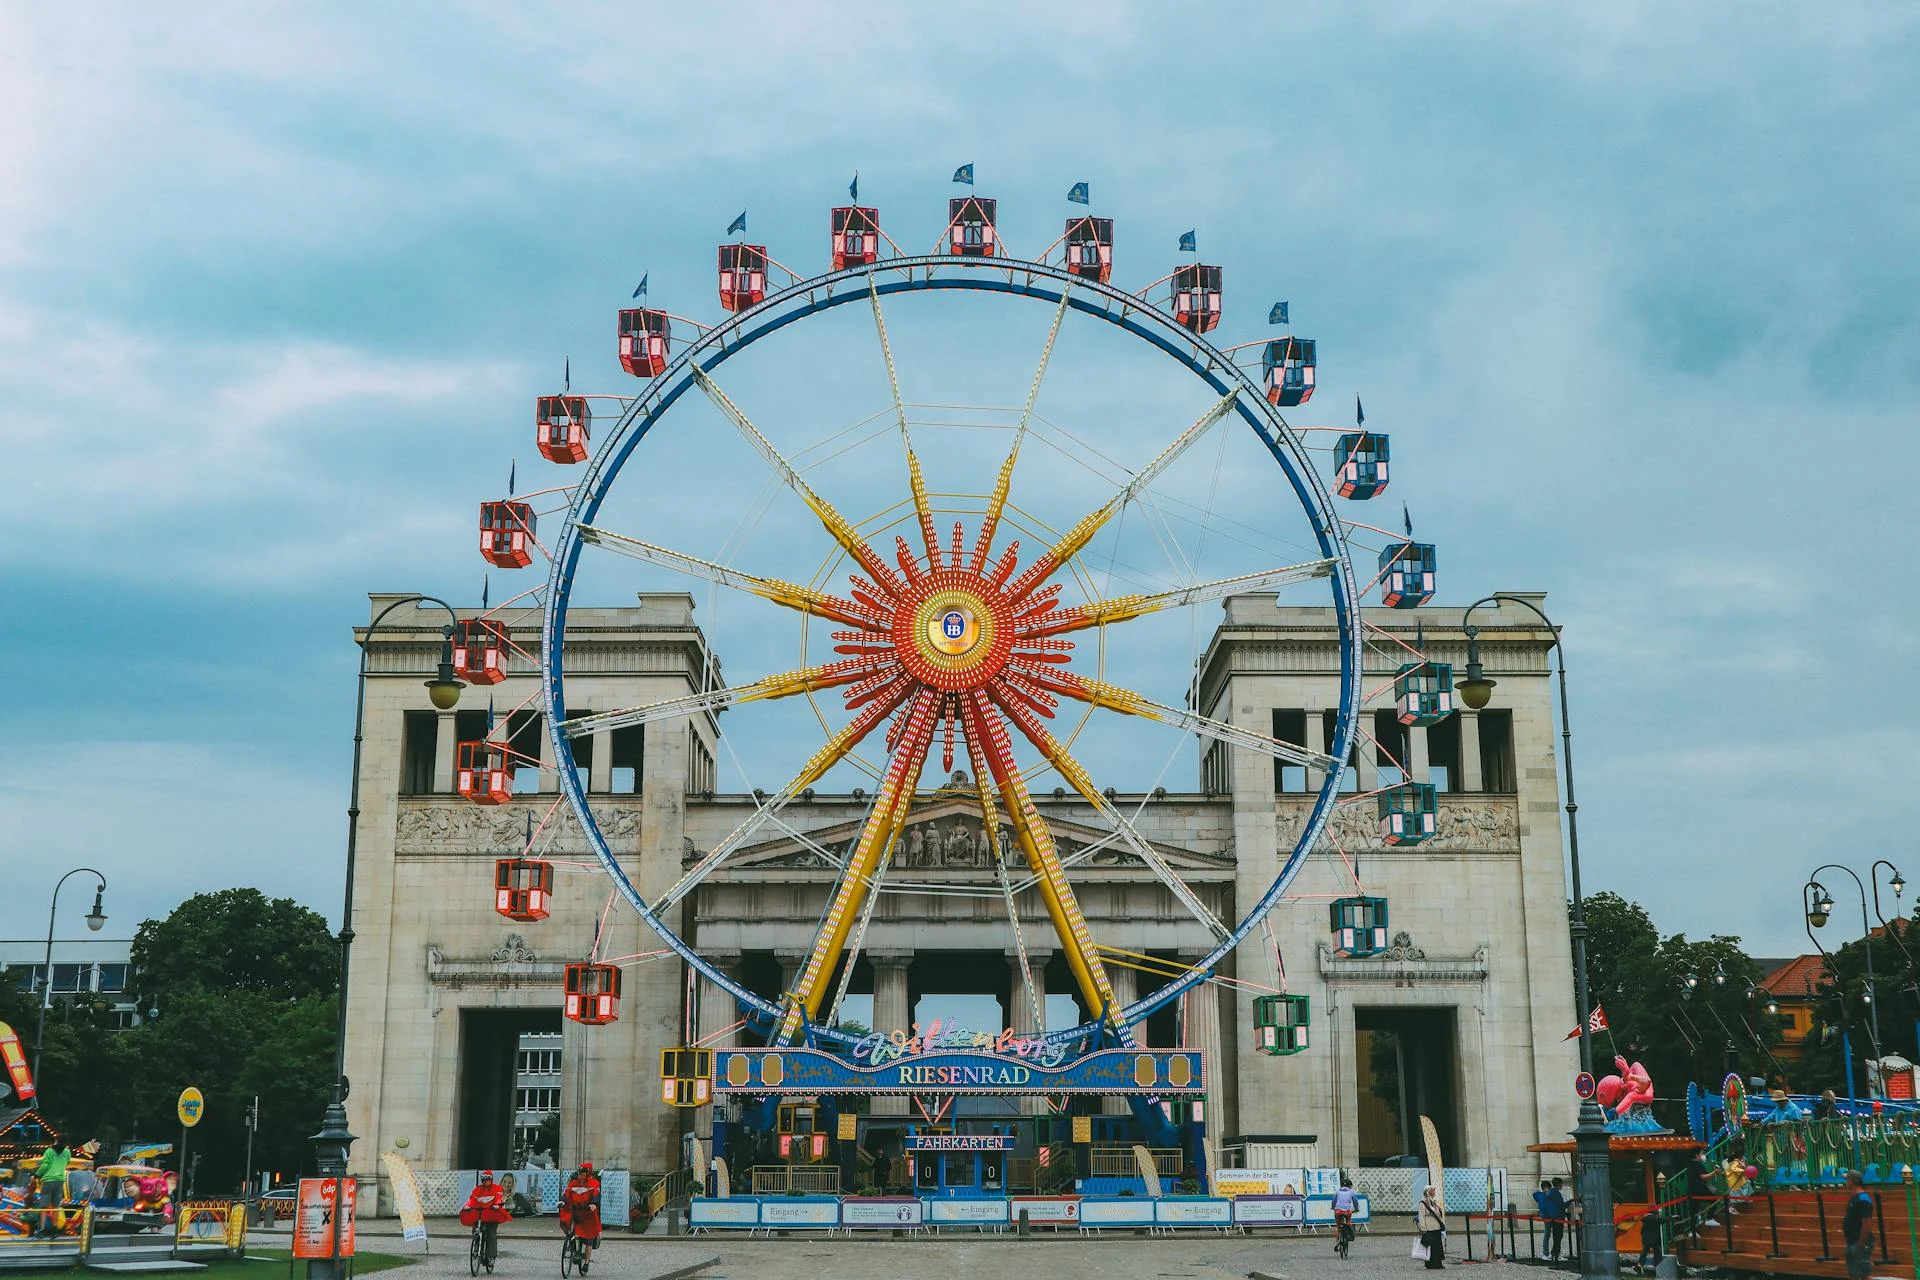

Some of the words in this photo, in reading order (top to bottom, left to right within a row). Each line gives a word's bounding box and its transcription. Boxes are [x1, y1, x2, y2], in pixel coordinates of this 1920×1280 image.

[947, 625, 961, 635] HB
[899, 1066, 1031, 1085] RIESENRAD
[916, 1137, 1004, 1149] FAHRKARTEN
[322, 1184, 336, 1194] ödp
[770, 1206, 800, 1217] Eingang
[970, 1205, 999, 1214] Eingang
[1194, 1206, 1222, 1215] Eingang
